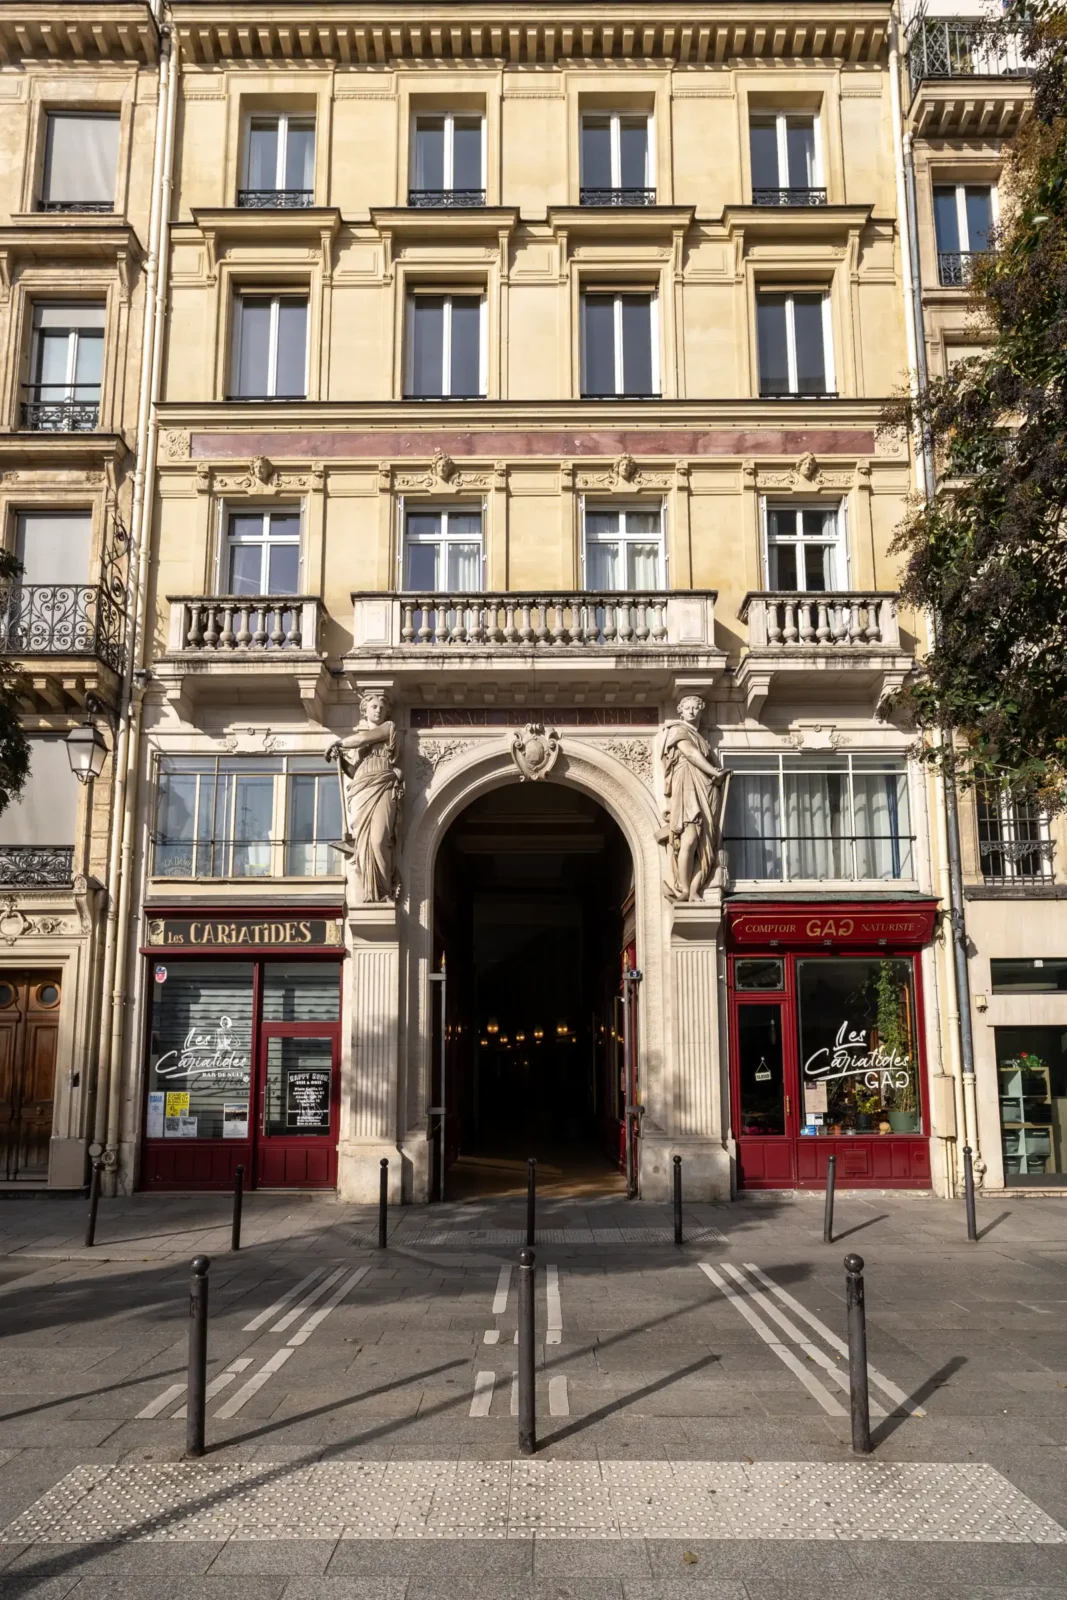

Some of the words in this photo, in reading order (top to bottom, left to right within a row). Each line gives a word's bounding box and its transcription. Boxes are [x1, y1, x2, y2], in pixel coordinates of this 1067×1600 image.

[427, 709, 491, 726] PASSAGE
[167, 931, 184, 944] Les
[745, 924, 797, 933] COMPTOIR
[861, 923, 915, 932] NATURISTE
[181, 1027, 212, 1053] Les
[833, 1020, 867, 1051] Les
[155, 1050, 247, 1074] Cariatides
[804, 1048, 910, 1075] Cariatides
